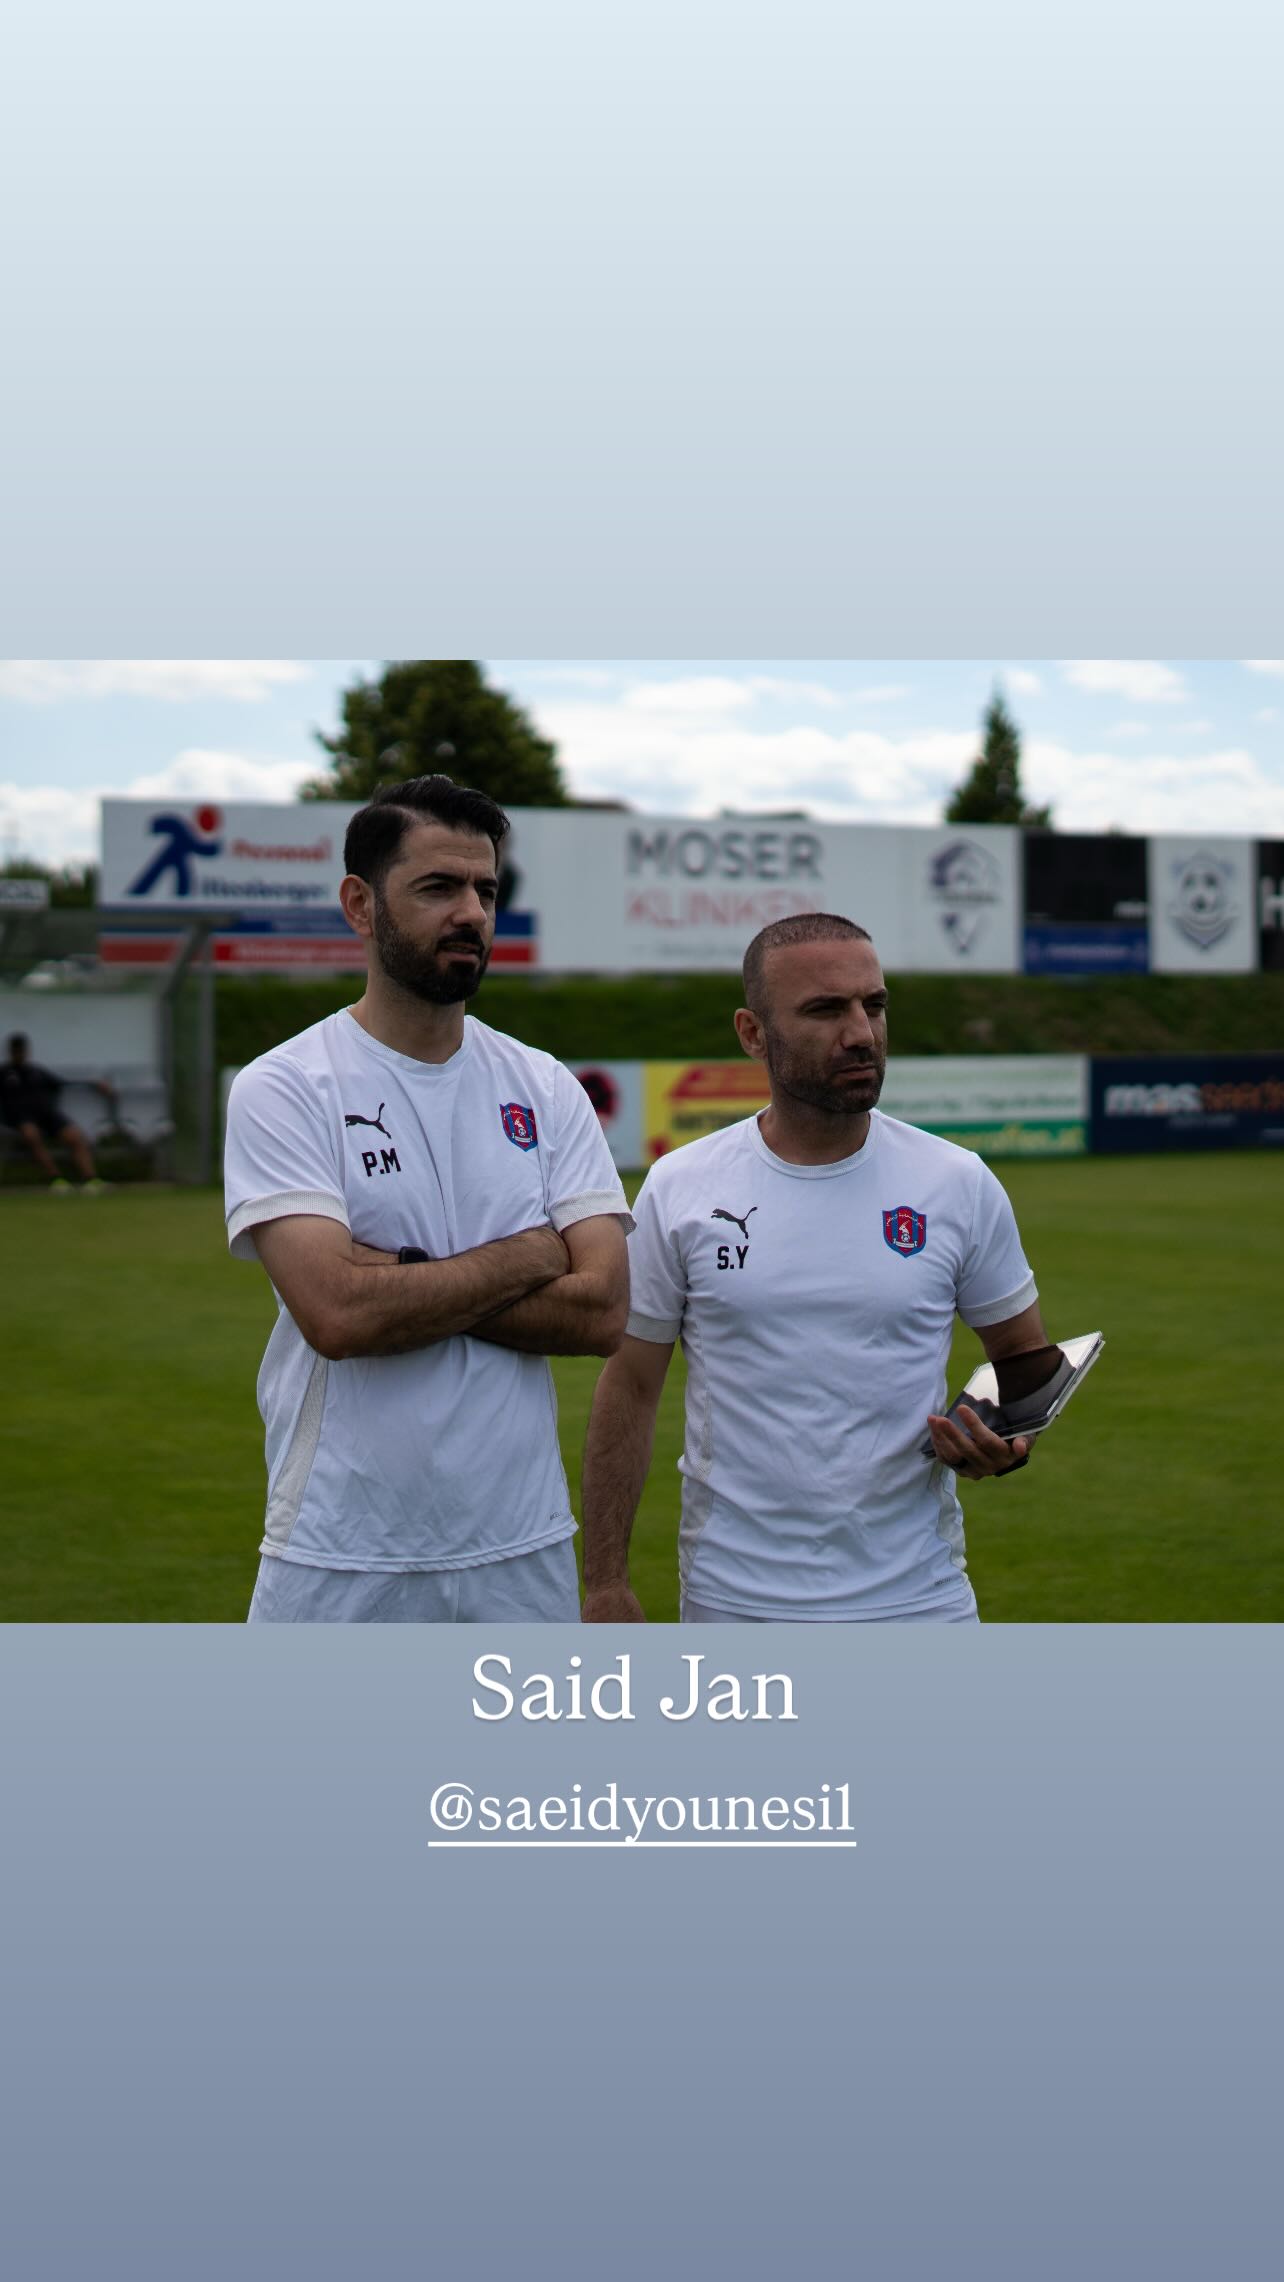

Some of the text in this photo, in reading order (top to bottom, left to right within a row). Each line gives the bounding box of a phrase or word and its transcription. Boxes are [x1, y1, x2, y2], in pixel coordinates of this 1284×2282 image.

[627, 829, 823, 879] MOSER
[361, 1147, 401, 1177] P.M
[717, 1245, 749, 1270] S.Y
